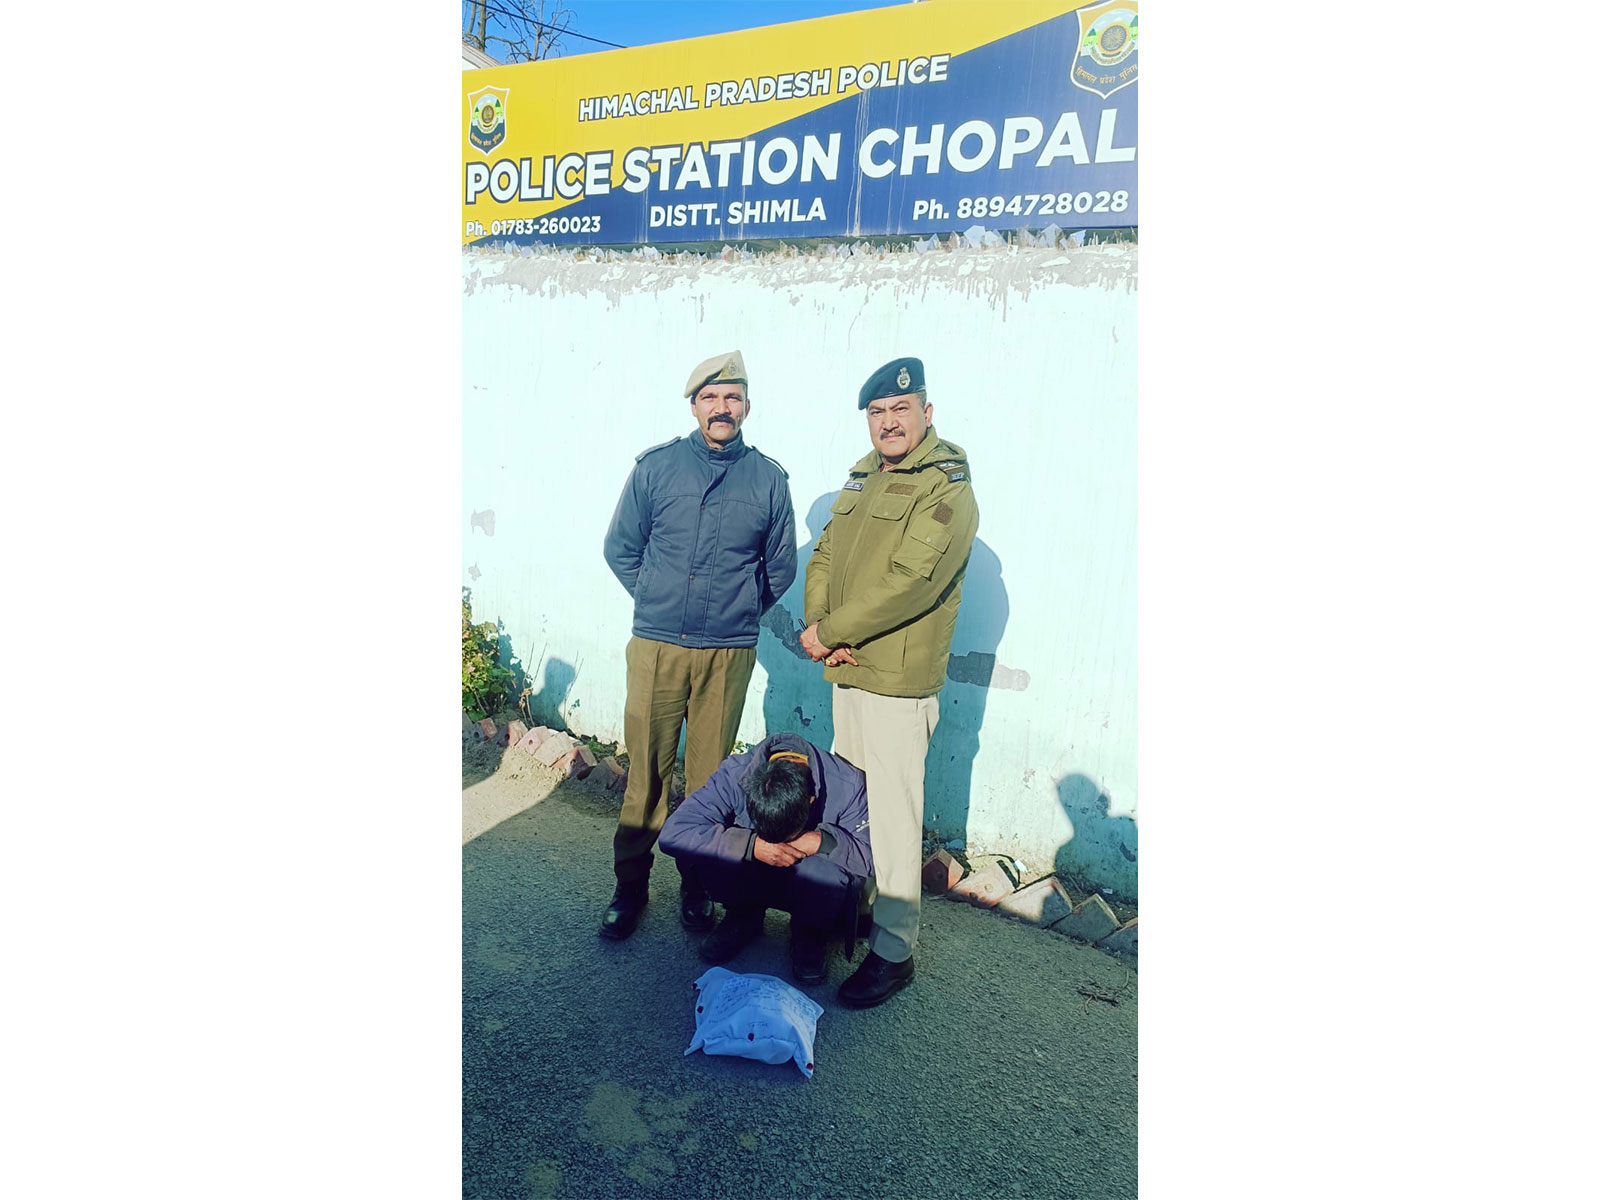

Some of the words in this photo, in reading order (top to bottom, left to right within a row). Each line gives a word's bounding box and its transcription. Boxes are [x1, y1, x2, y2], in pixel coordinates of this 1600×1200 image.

[578, 86, 699, 122] HIMACHAL
[704, 67, 831, 108] PRADESH
[837, 53, 951, 94] POLICE
[465, 150, 614, 205] POLICE
[622, 132, 842, 194] STATION
[859, 108, 1137, 179] CHOPAL
[649, 203, 721, 228] DISTT.
[727, 197, 827, 224] SHIMLA
[913, 199, 950, 221] Ph.
[957, 190, 1129, 218] 8894728028
[465, 221, 487, 237] Ph.
[491, 215, 601, 236] 01783-260023
